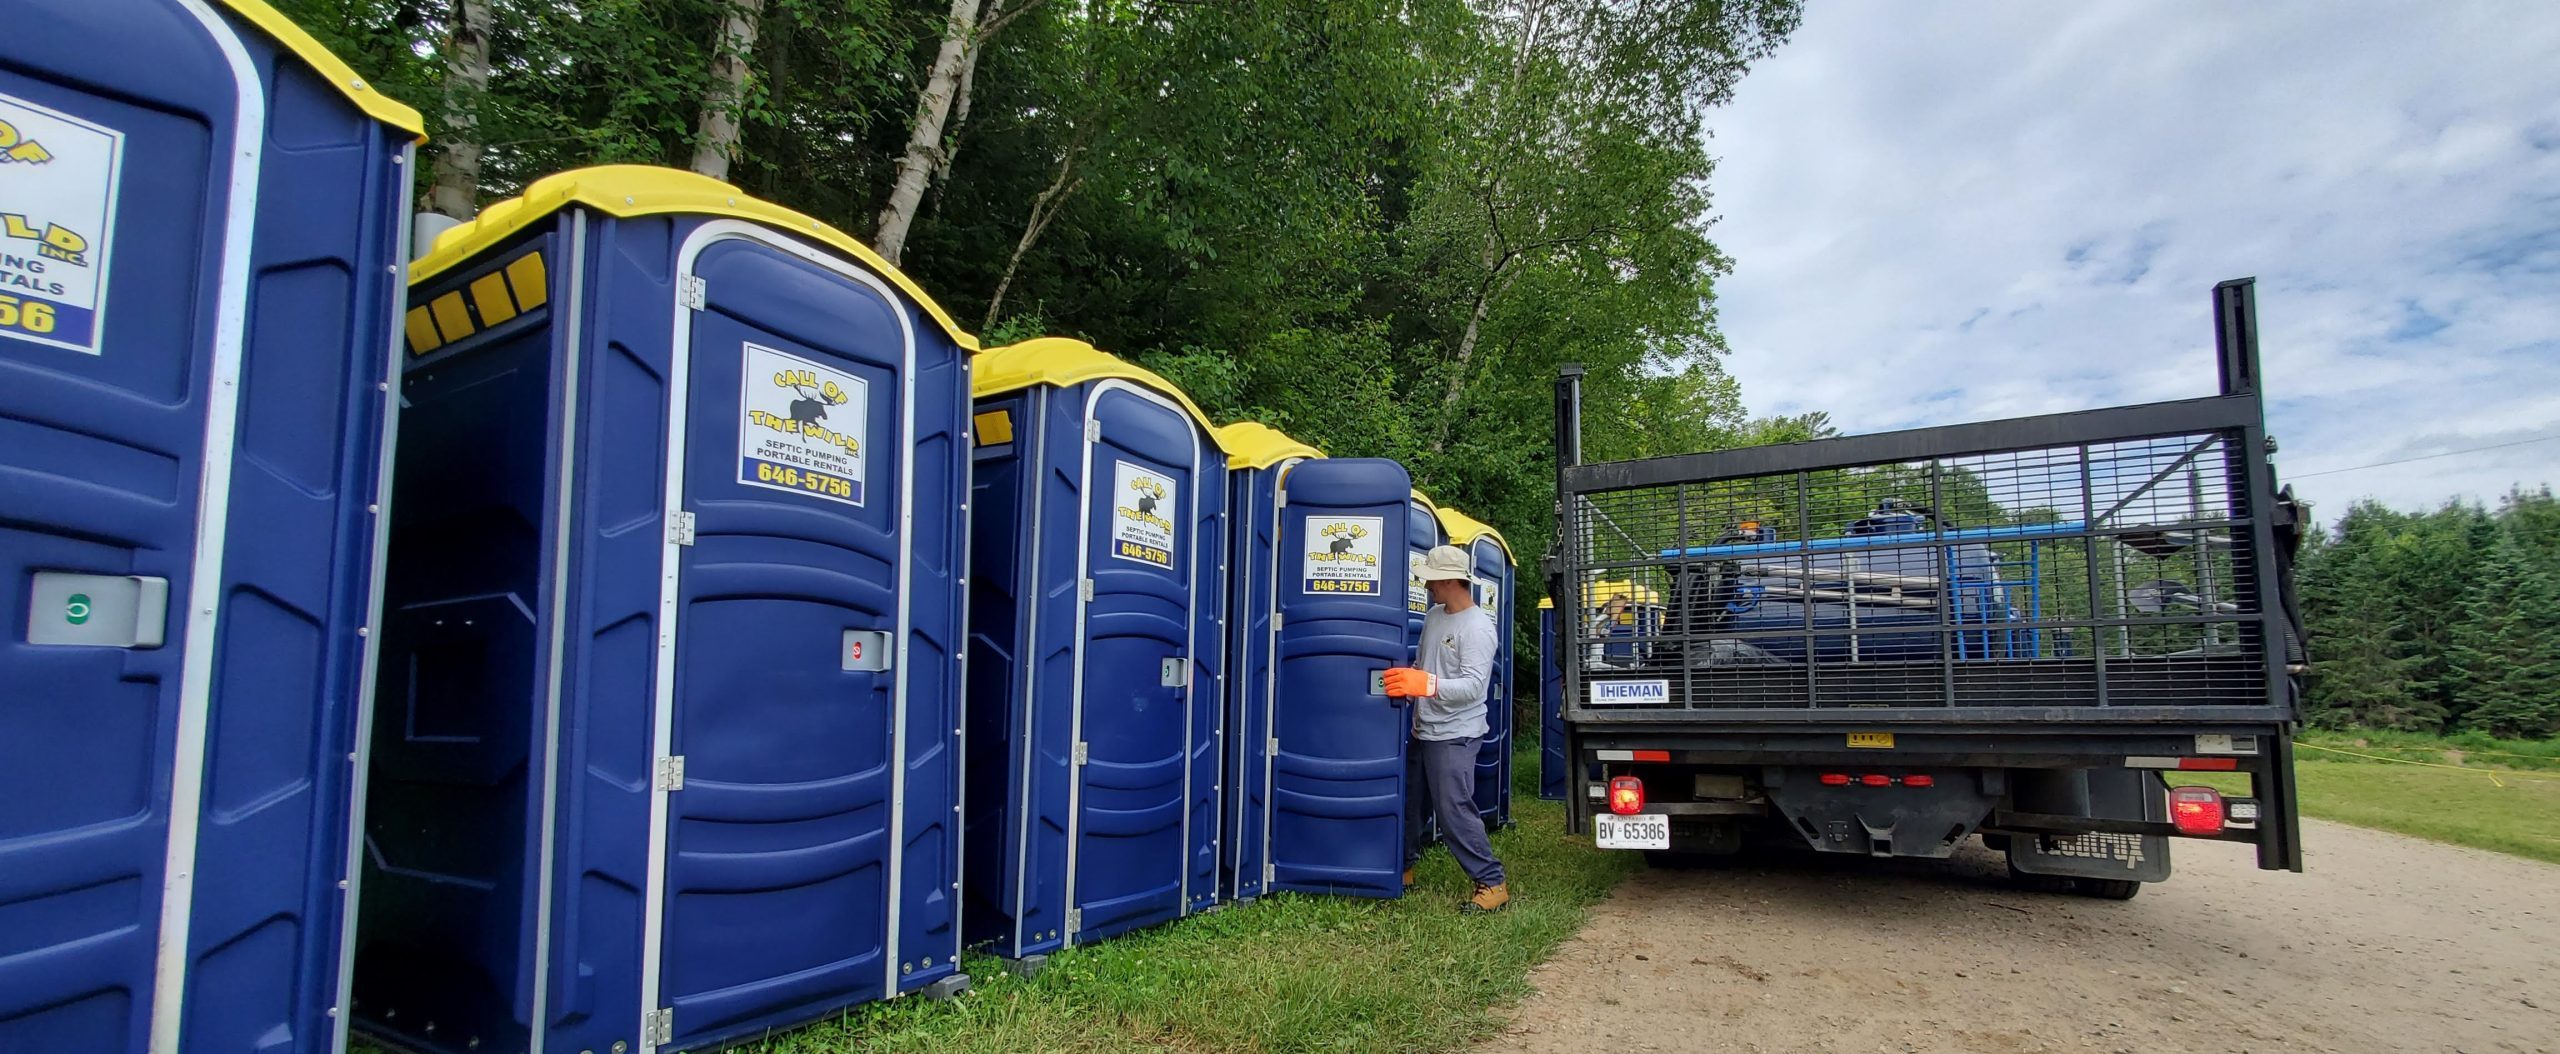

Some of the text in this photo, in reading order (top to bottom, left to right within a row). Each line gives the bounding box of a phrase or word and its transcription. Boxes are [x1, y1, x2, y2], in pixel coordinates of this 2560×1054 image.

[774, 369, 849, 405] CALL OF
[749, 410, 860, 451] THE WILD
[766, 439, 848, 465] SEPTIC PUMPING
[757, 447, 854, 476] PORTABLE RENTALS
[757, 462, 852, 497] 646-5756
[1131, 476, 1153, 490] CALL
[1118, 506, 1143, 521] THE
[1126, 526, 1145, 536] SEPTIC
[1145, 530, 1166, 541] PUMPING
[1321, 523, 1347, 536] CALL
[1122, 532, 1168, 549] PORTABLE RENTALS
[1121, 542, 1167, 564] 646-5756
[1309, 552, 1376, 564] THE WILD
[1313, 580, 1370, 592] 646-5756
[1596, 681, 1663, 698] THIEMAN
[1599, 822, 1615, 840] BV
[1624, 822, 1666, 840] 65386
